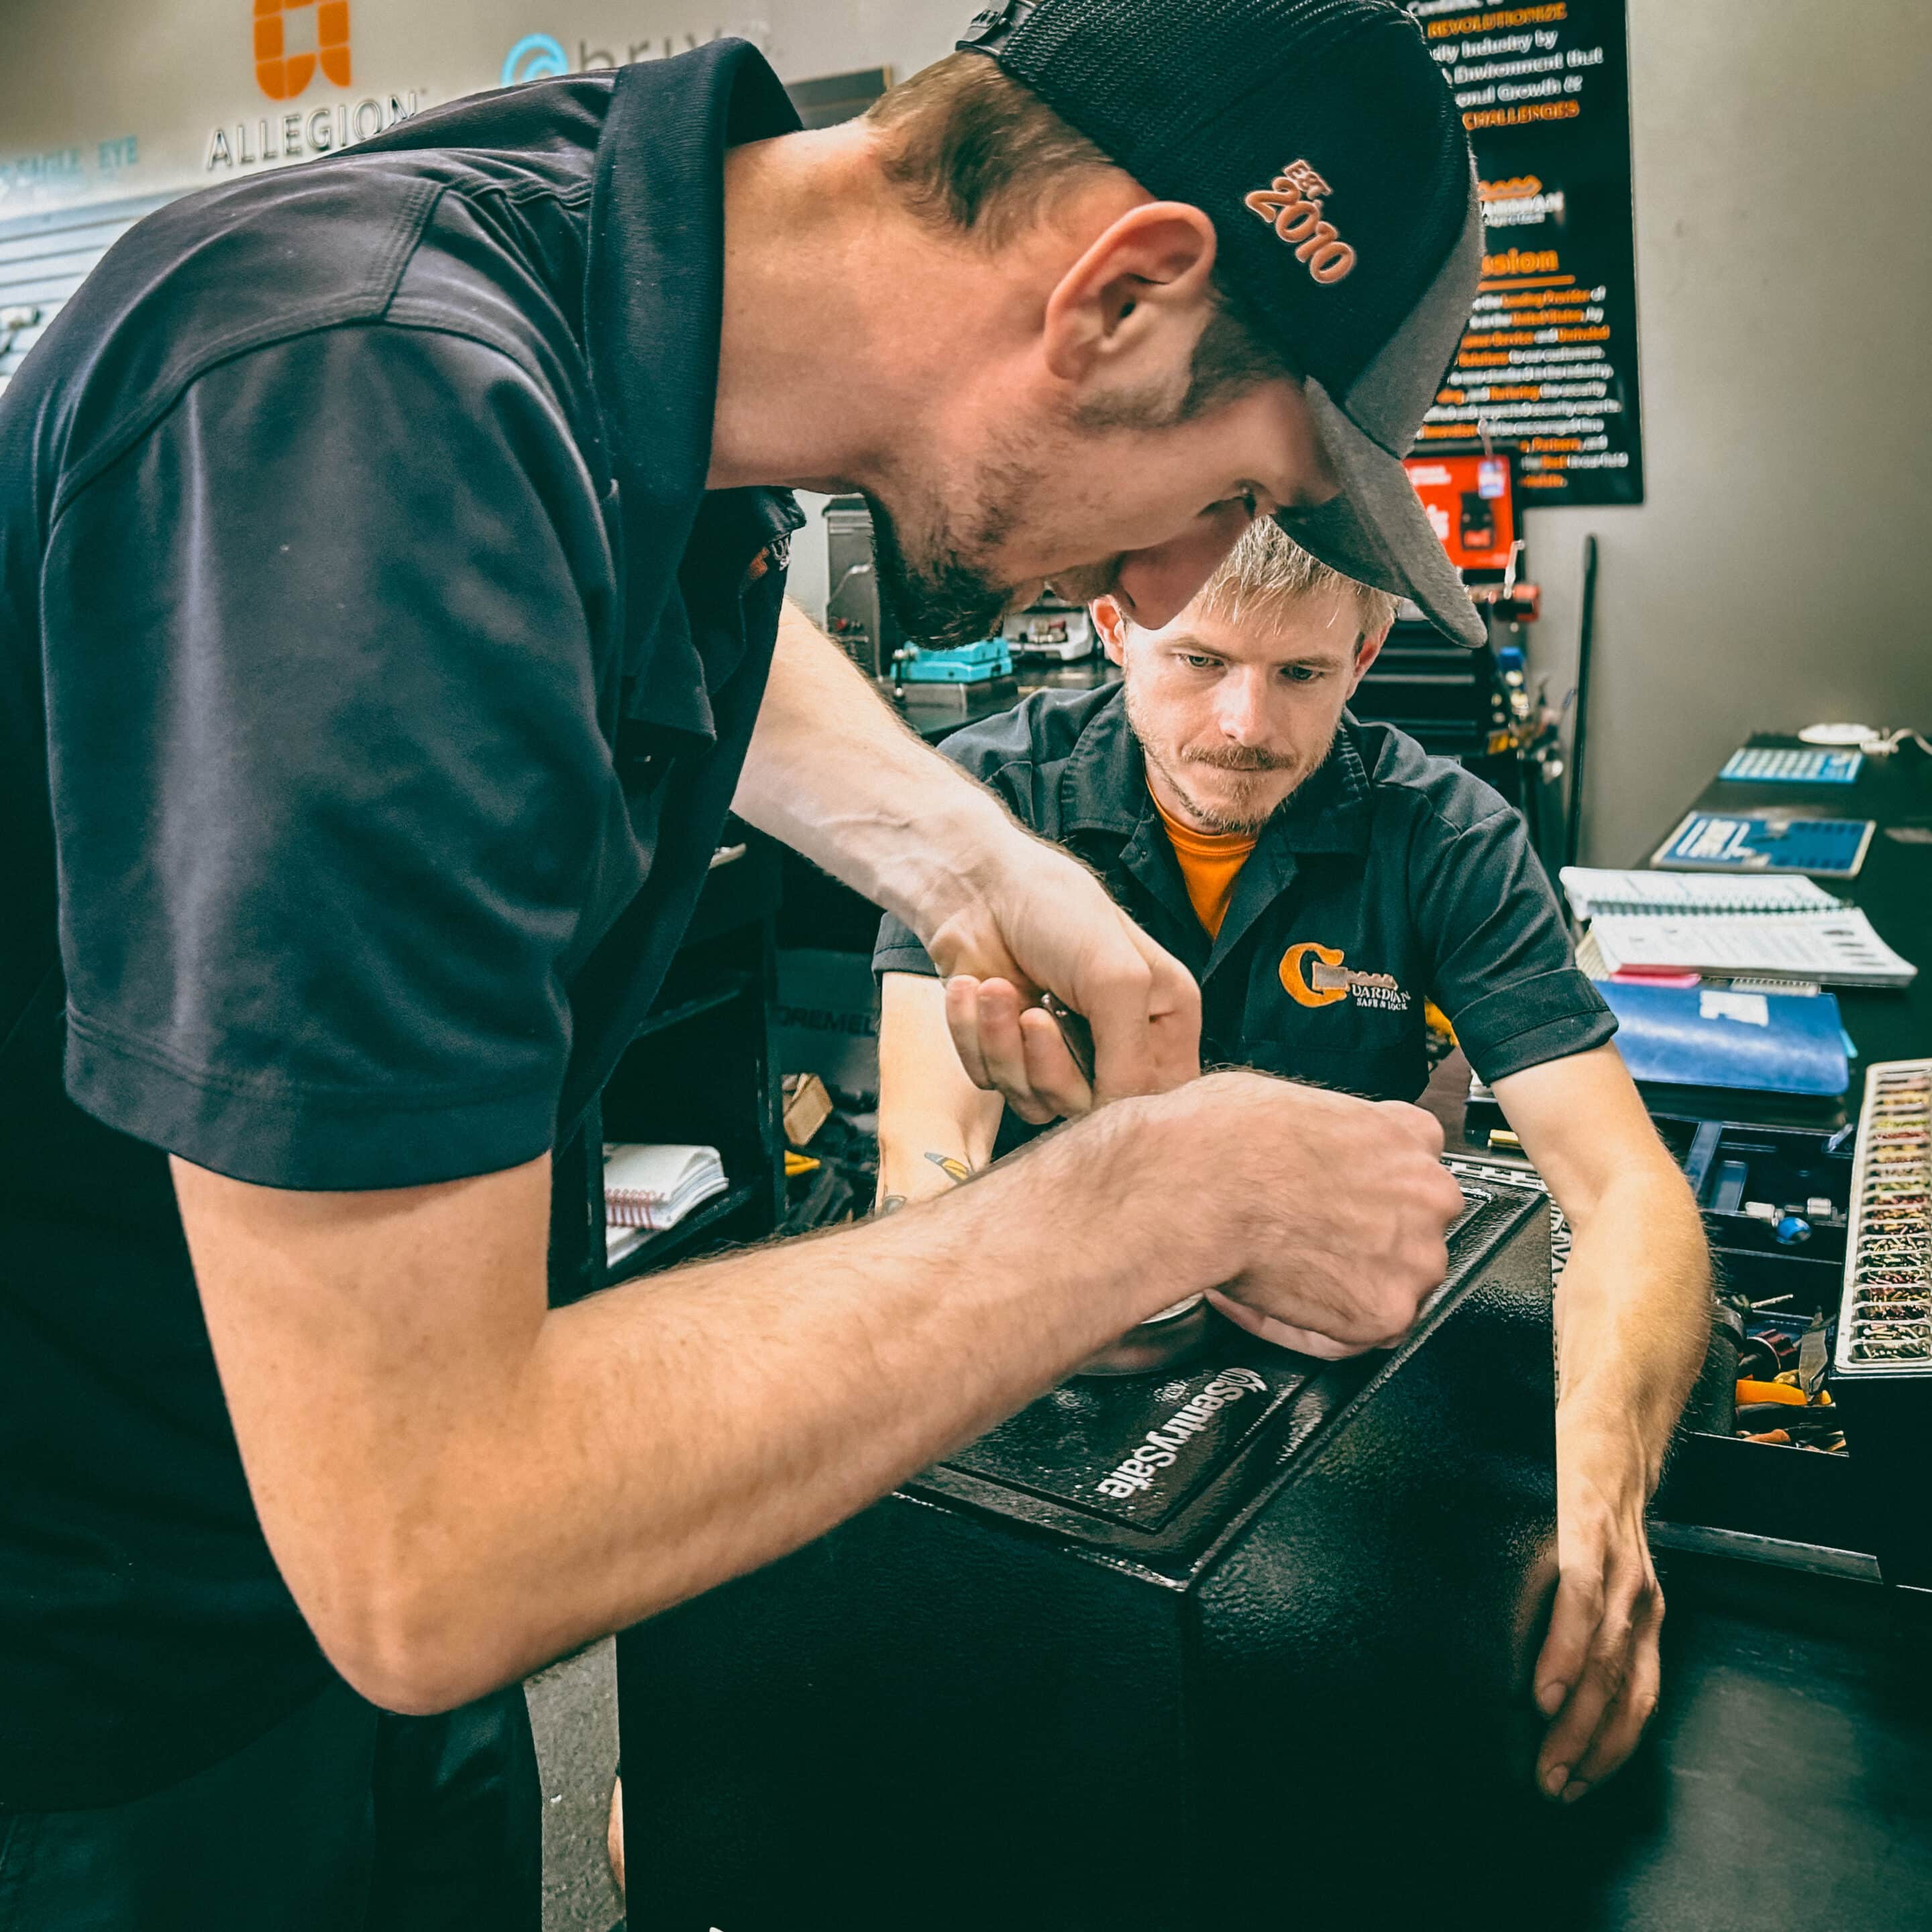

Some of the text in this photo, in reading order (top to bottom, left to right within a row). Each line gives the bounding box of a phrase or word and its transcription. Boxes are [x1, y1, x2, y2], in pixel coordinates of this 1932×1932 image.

[1428, 3, 1568, 38] REVOLUTIONIZE
[1534, 30, 1558, 49] by
[1497, 77, 1562, 101] Growth
[1462, 99, 1580, 131] CHALLENGES
[1244, 176, 1355, 284] 2010
